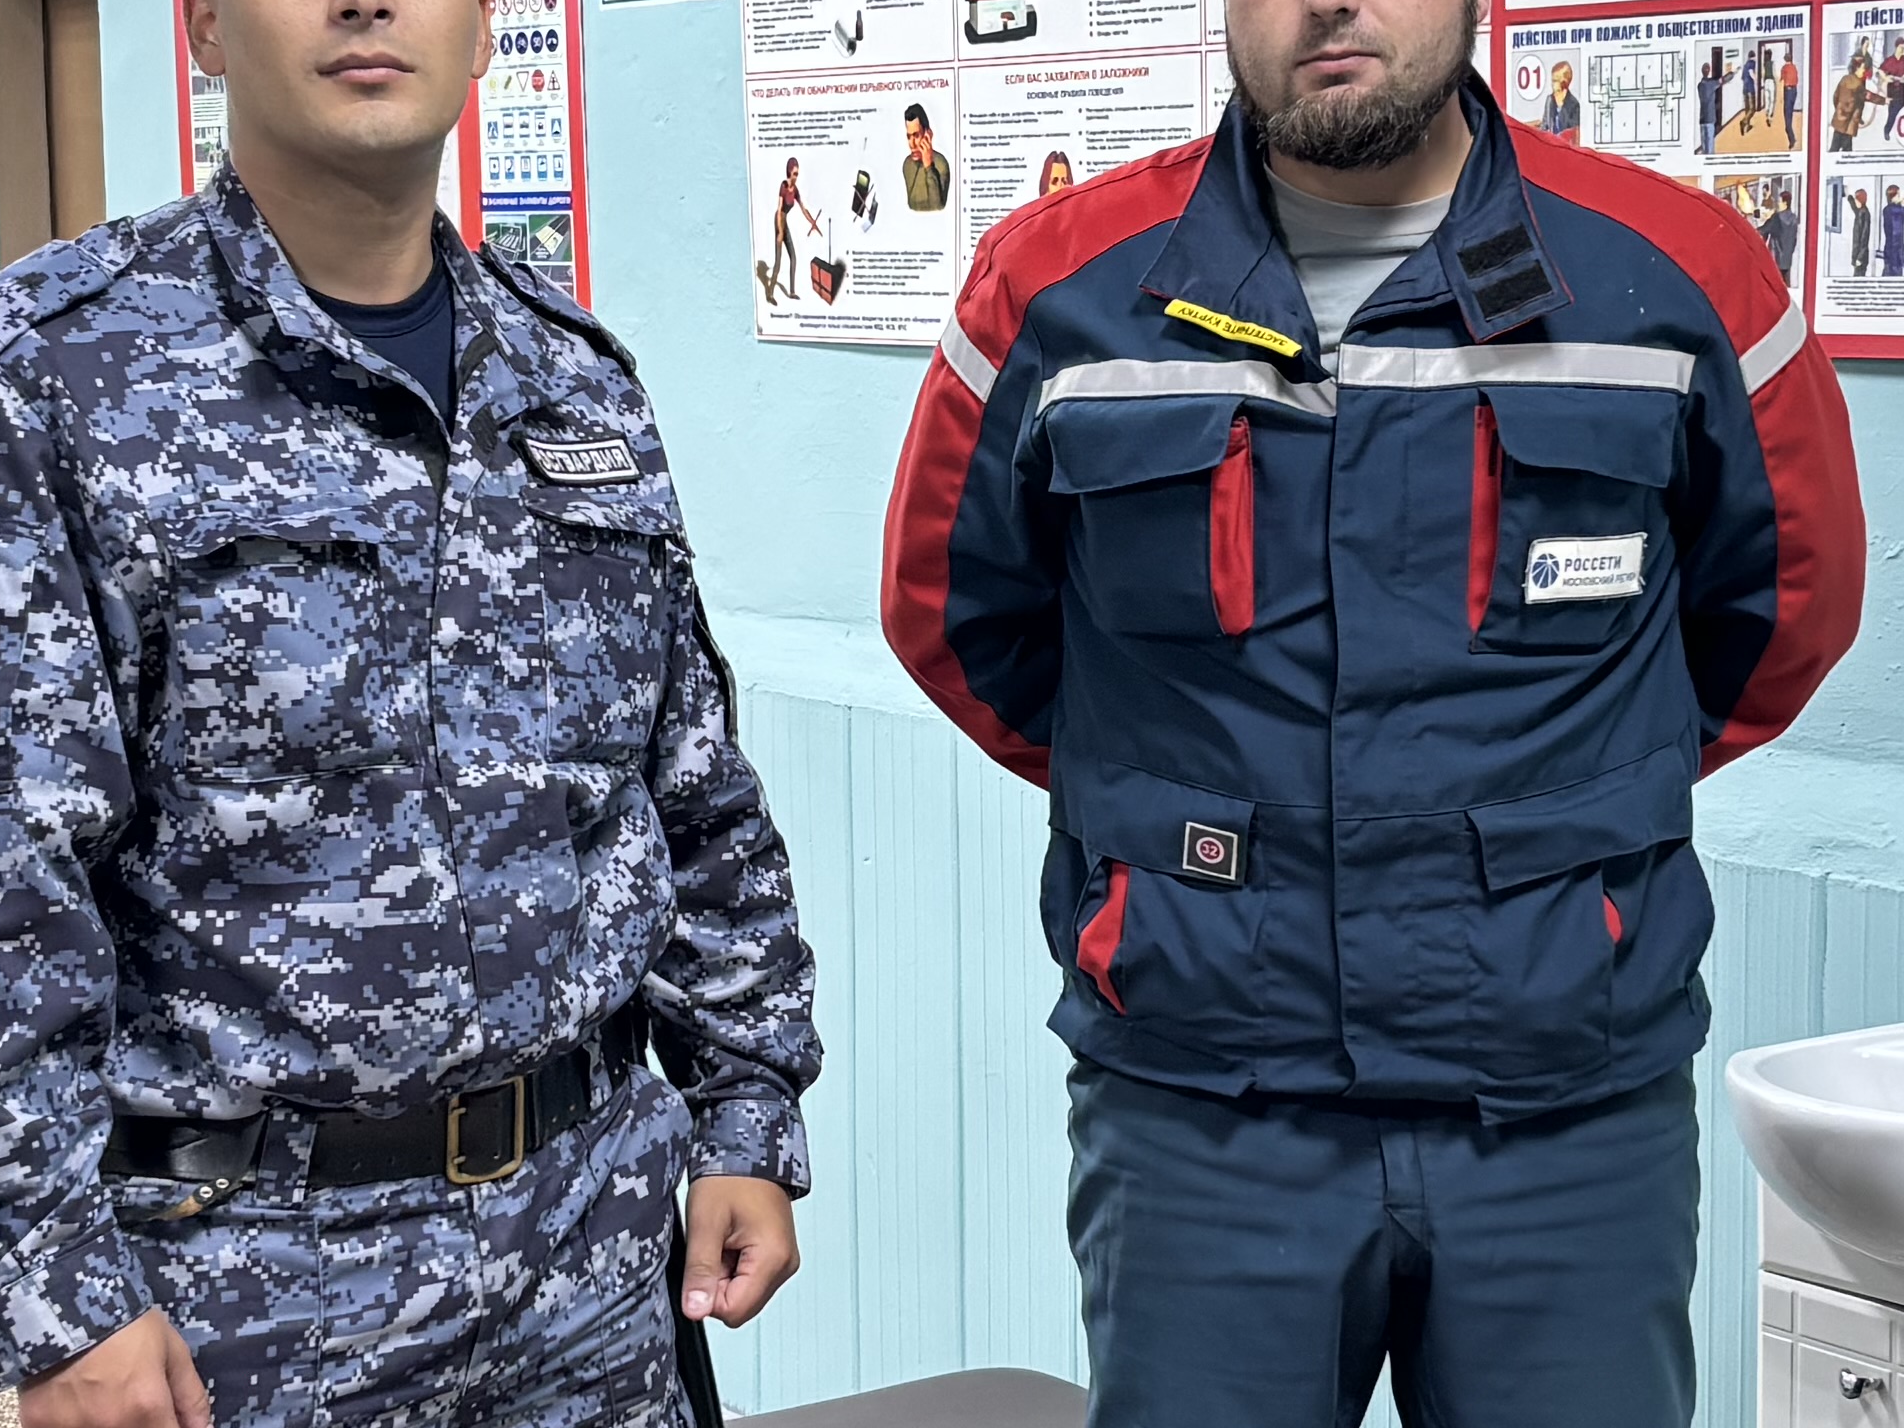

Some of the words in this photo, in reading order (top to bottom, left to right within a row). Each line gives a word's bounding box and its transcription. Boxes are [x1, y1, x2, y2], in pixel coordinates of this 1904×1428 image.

[1513, 29, 1566, 48] ДЕЙСТВИЯ
[1571, 28, 1592, 43] ПРИ
[1596, 25, 1641, 42] ПОЖАРЕ
[1658, 17, 1751, 38] ОБЩЕСТВЕННОМ
[1756, 13, 1803, 31] ЗДАНИИ
[903, 78, 949, 90] УСТРОЙСТВА
[1518, 67, 1540, 90] 01
[1178, 307, 1222, 329] КУРТКУ
[1564, 556, 1622, 572] РОССЕТИ
